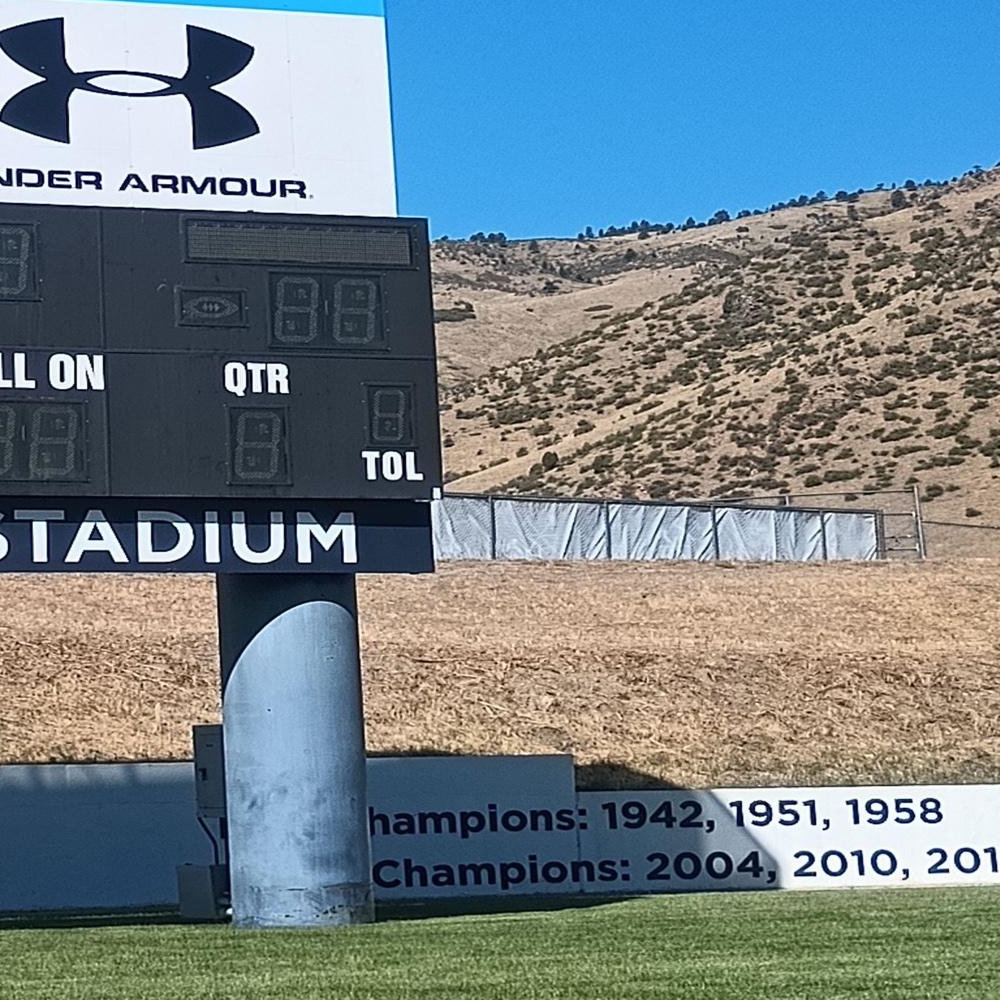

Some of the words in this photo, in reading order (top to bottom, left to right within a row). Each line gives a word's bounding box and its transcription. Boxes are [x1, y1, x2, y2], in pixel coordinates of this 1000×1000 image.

[118, 172, 308, 200] ARMOUR
[47, 353, 106, 391] ON
[223, 361, 291, 397] QTR
[361, 450, 424, 482] TOL
[368, 803, 588, 839] hampions:
[601, 800, 716, 834] 1942,
[729, 798, 831, 831] 1951,
[845, 796, 944, 826] 1958
[371, 854, 630, 891] Champions:
[646, 850, 777, 884] 2004,
[792, 848, 910, 881] 2010,
[926, 845, 1000, 875] 201
